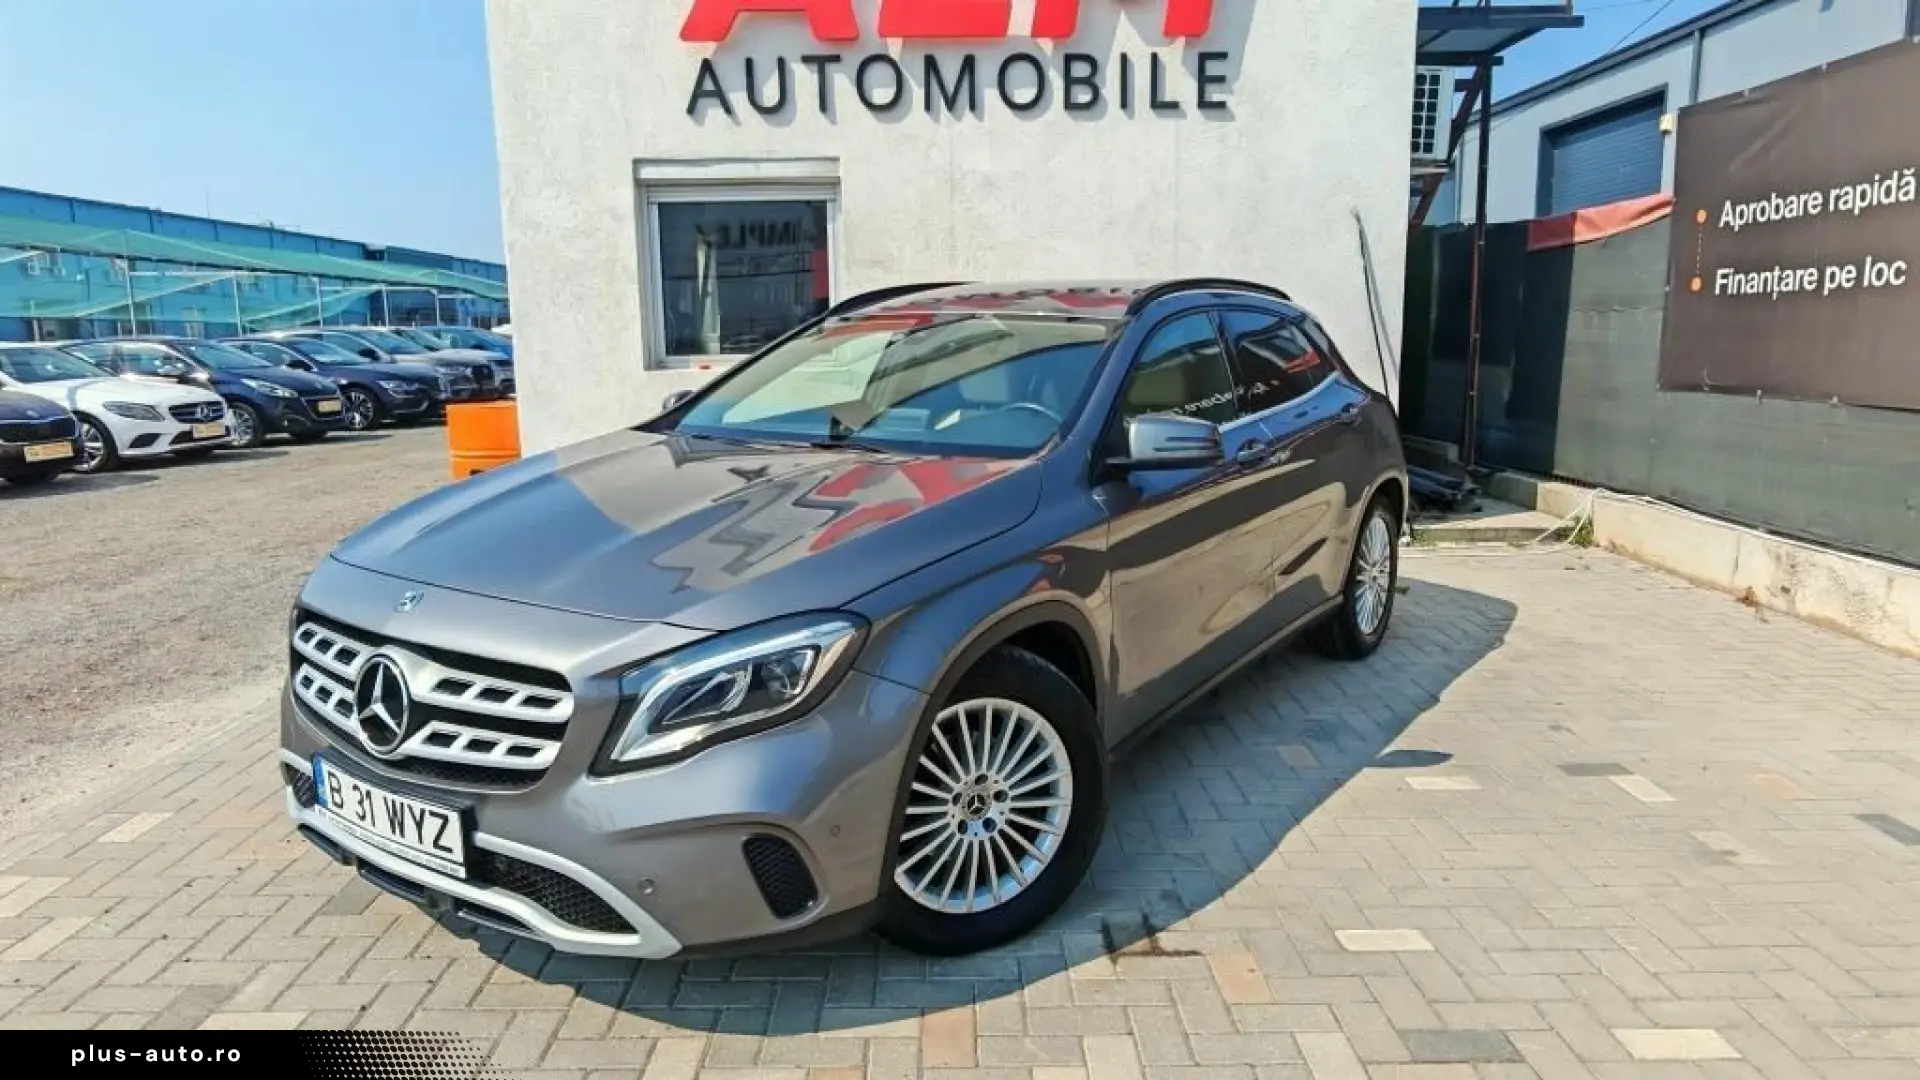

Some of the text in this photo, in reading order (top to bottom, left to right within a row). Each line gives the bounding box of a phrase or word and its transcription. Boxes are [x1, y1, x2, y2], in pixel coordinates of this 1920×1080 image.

[686, 51, 1230, 116] AUTOMOBILE
[1719, 167, 1917, 232] Aprobare rapidă
[1714, 256, 1906, 300] Finanțare pe loc
[328, 771, 344, 809] B
[352, 783, 376, 828] 31
[383, 796, 453, 854] WYZ
